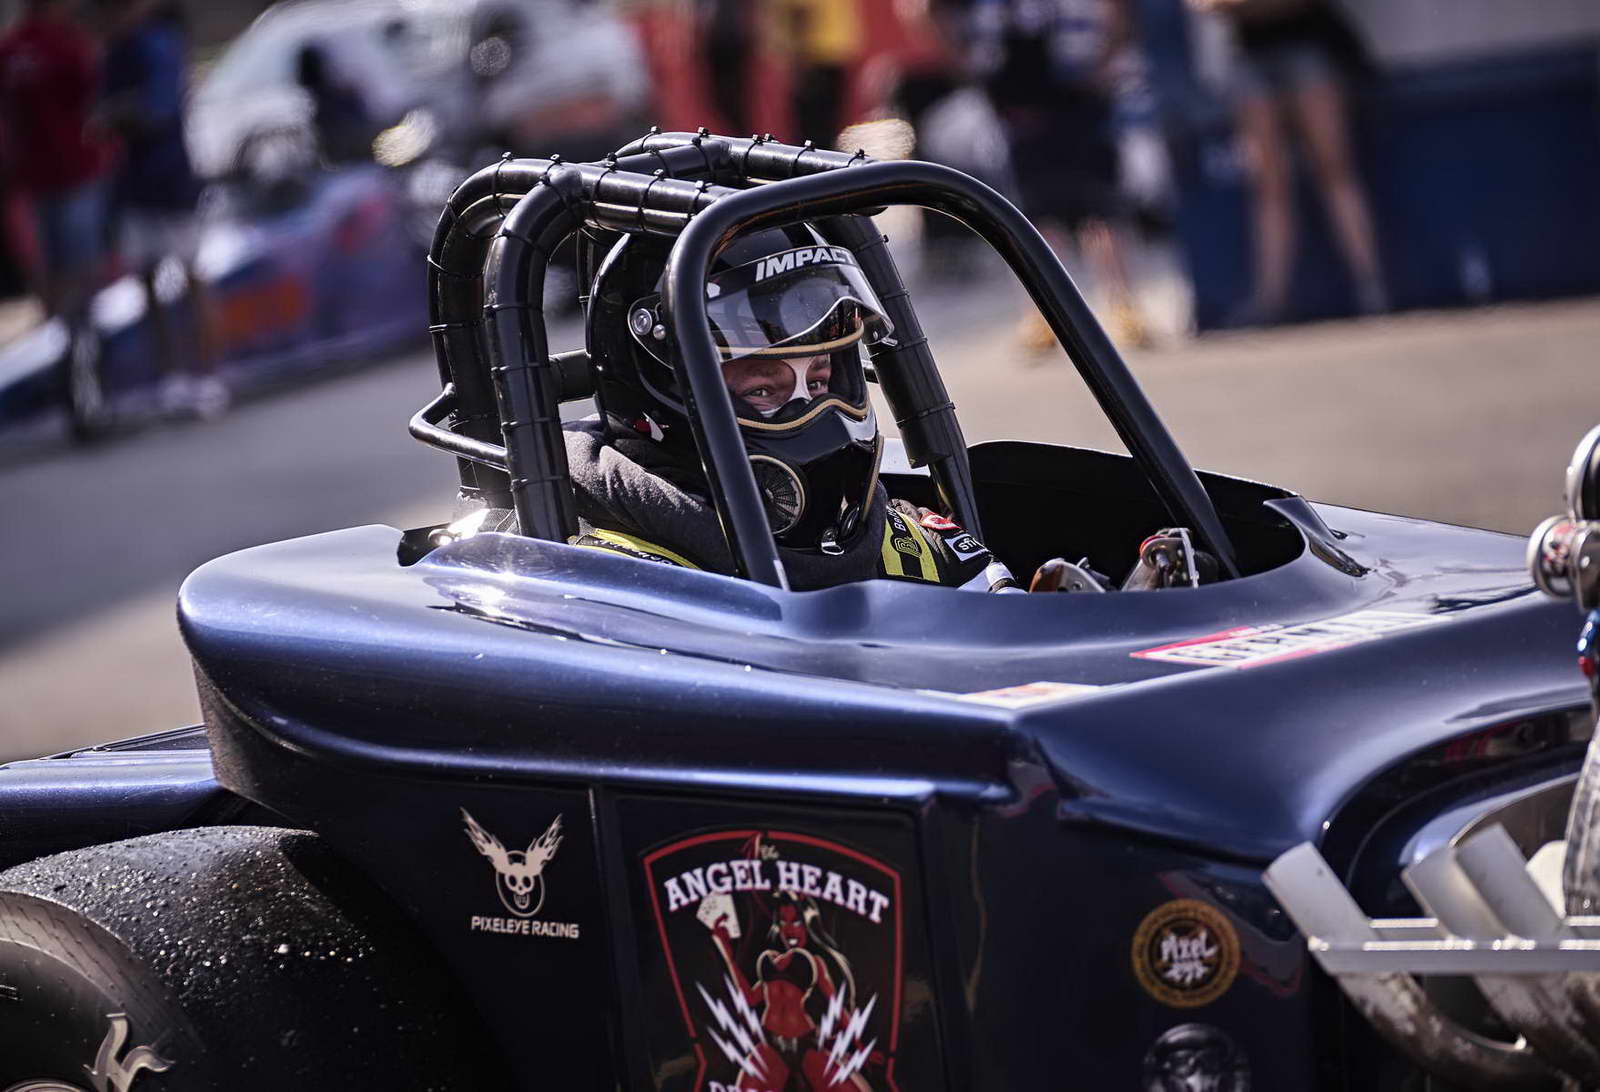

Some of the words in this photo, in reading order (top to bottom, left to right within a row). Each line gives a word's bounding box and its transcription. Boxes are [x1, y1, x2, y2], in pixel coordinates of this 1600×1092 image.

[755, 247, 854, 282] IMPACT
[664, 859, 771, 912] ANGEL
[776, 860, 889, 924] HEART
[470, 915, 530, 935] PIXELEYE
[531, 921, 580, 939] RACING
